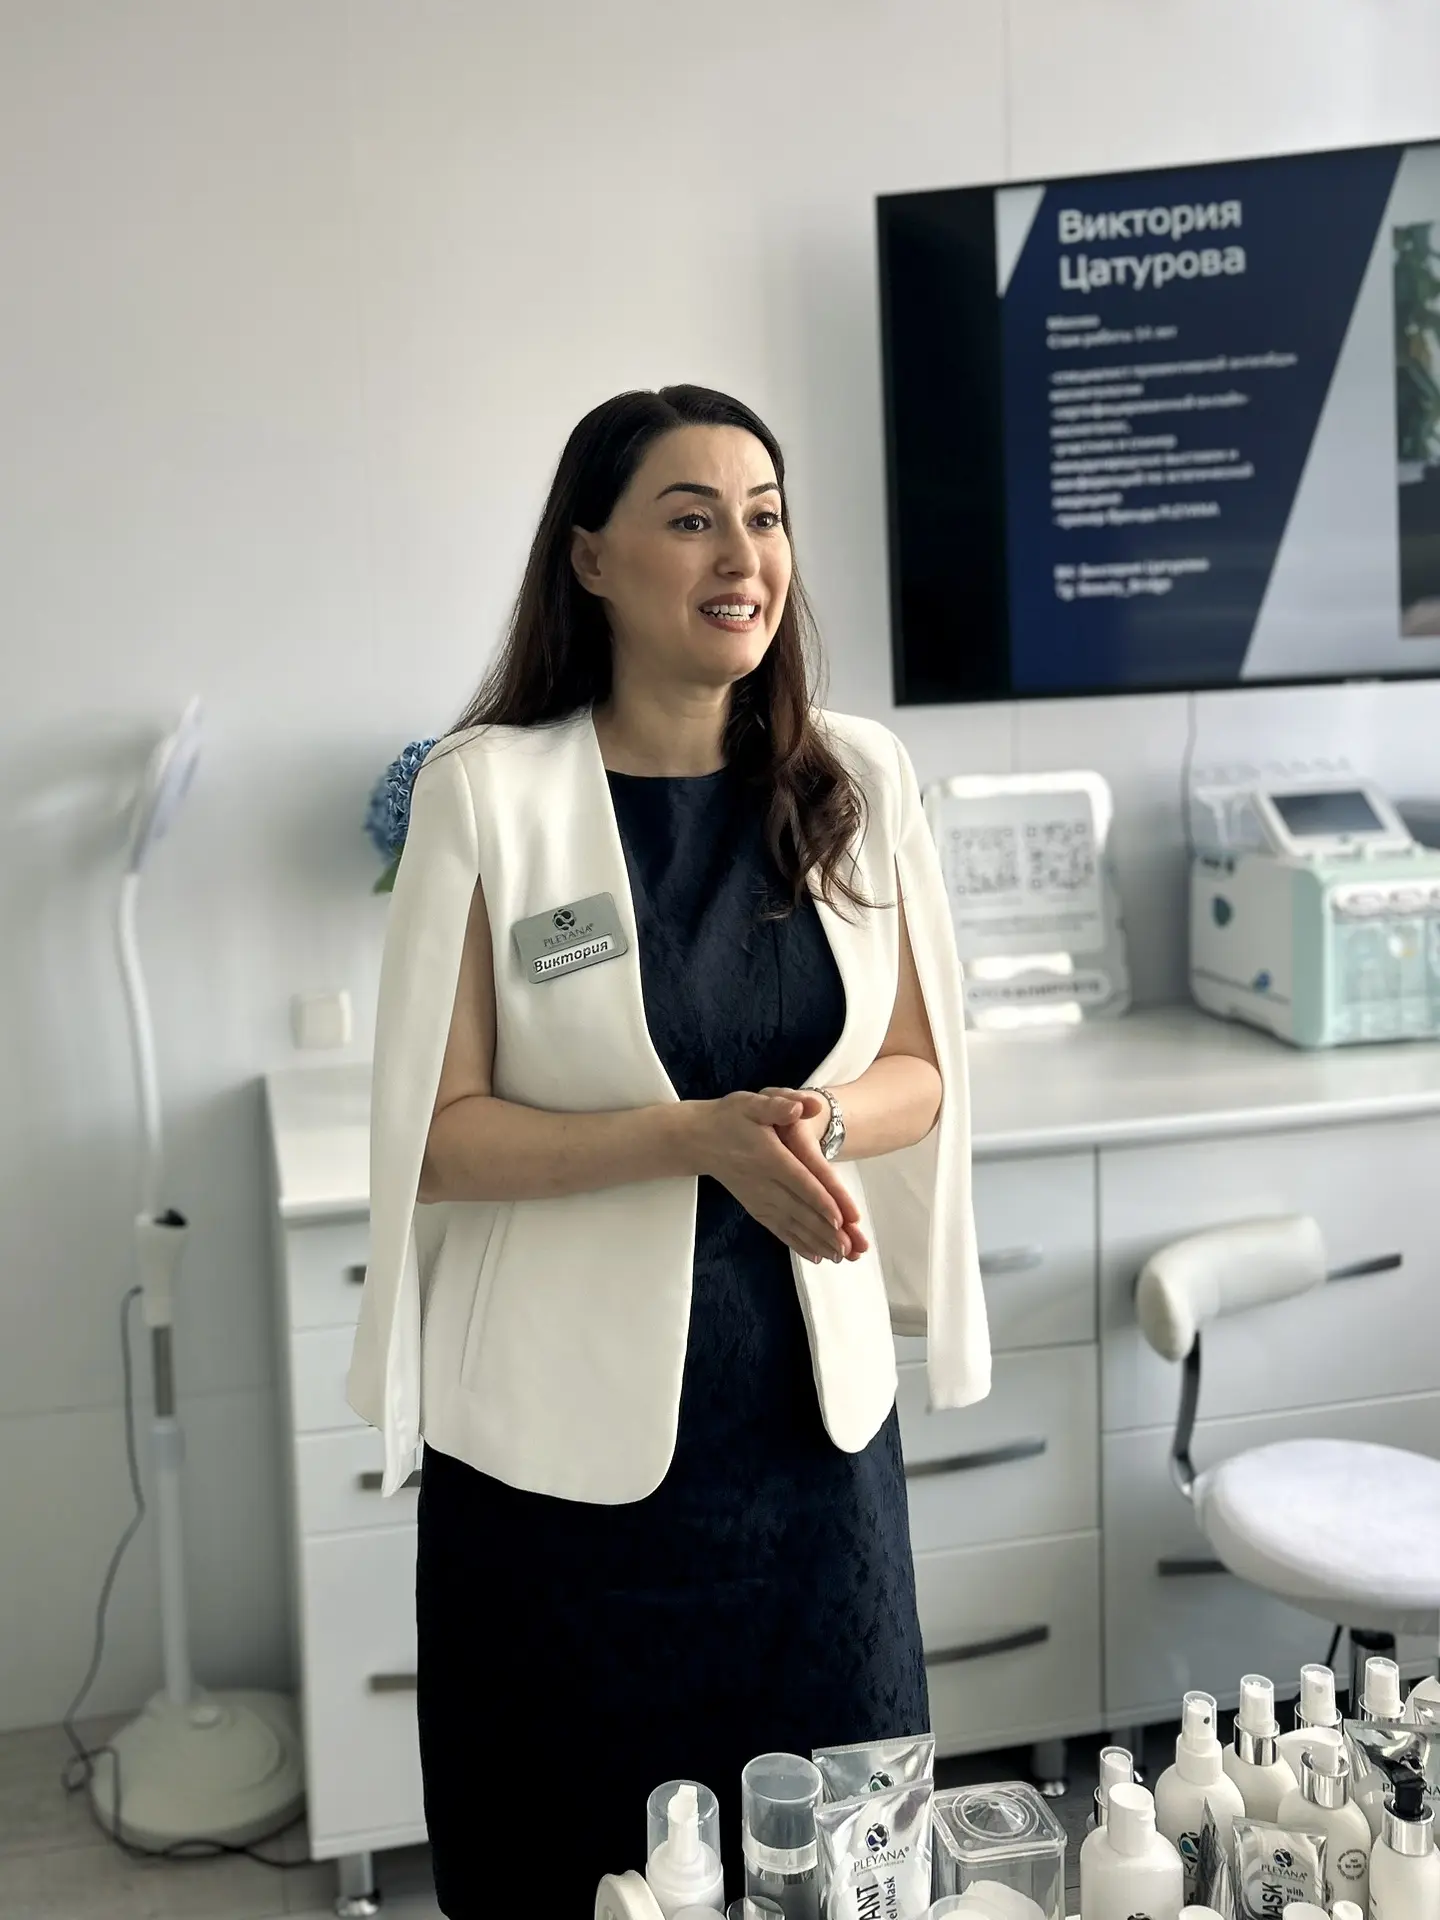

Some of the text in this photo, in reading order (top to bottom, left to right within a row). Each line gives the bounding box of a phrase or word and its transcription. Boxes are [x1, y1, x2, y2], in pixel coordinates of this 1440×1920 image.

[1058, 200, 1242, 244] Виктория
[1059, 246, 1246, 294] Цатурова
[534, 941, 608, 973] Виктория
[883, 1876, 898, 1920] el Mask
[1286, 1887, 1304, 1898] with
